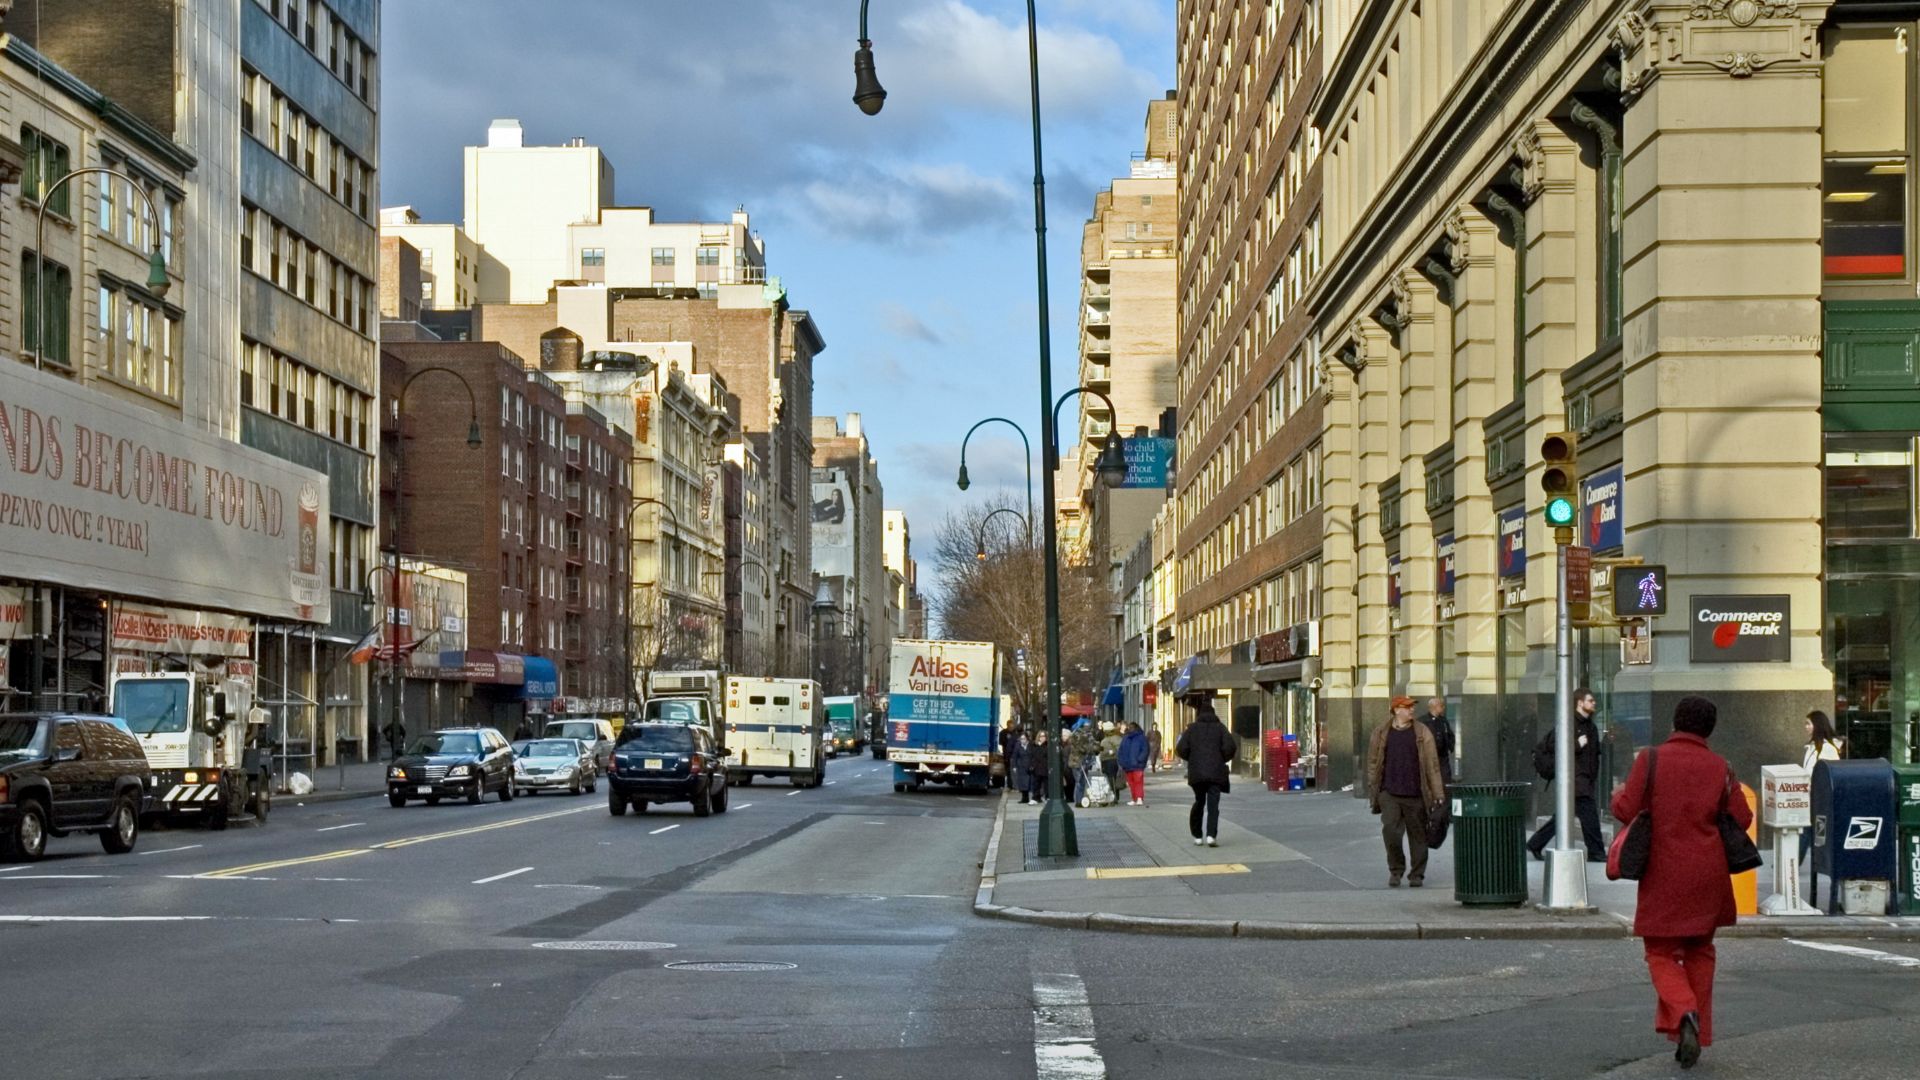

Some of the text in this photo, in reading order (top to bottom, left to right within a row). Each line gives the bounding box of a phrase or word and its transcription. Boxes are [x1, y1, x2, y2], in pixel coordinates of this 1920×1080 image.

[1134, 442, 1155, 452] child
[1145, 453, 1156, 462] be
[73, 424, 197, 516] BECOME
[1128, 464, 1152, 473] ithout
[1586, 481, 1618, 507] Commerce
[1601, 500, 1617, 524] Bank
[47, 503, 93, 542] ONCE
[1501, 516, 1524, 537] Commerce
[1698, 608, 1783, 622] Commerce
[168, 622, 207, 642] FITNESS
[207, 626, 226, 643] FOR
[1739, 622, 1781, 635] Bank
[909, 655, 969, 679] Atlas
[908, 679, 969, 694] Van Lines
[912, 699, 955, 709] CERTIFIED
[1777, 800, 1809, 810] CLASSES
